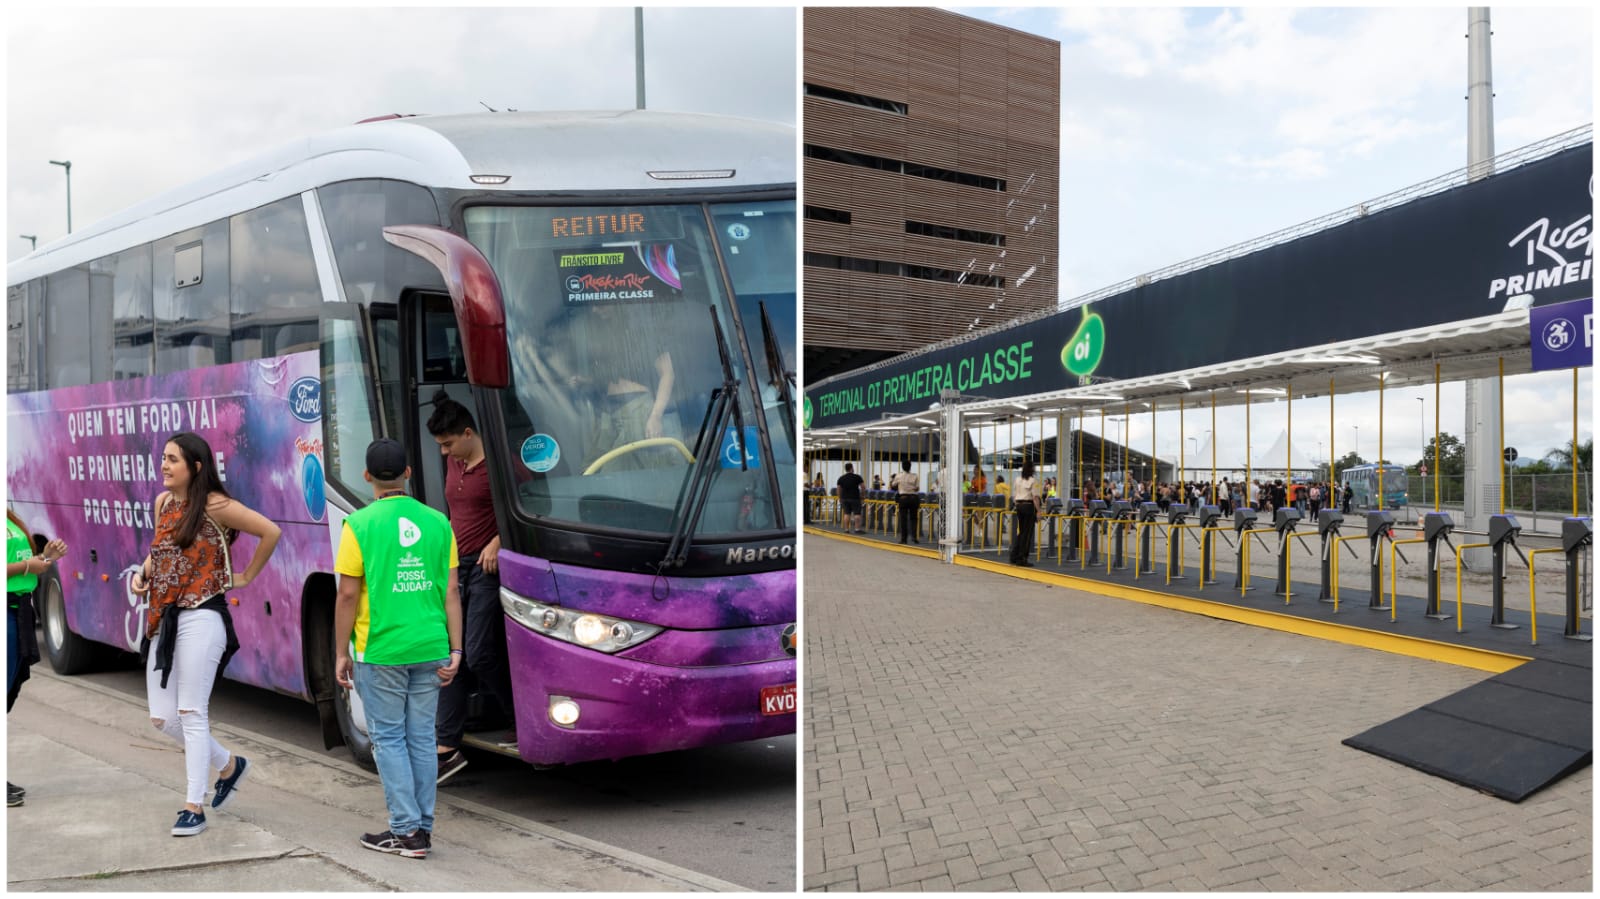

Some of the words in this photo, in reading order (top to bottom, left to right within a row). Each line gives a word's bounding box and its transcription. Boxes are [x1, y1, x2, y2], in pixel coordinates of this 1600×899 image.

[552, 213, 645, 237] REITUR
[600, 254, 622, 264] LIVRE
[568, 291, 617, 302] PRIMEIRA
[618, 290, 653, 299] CLASSE
[1074, 333, 1090, 360] oi
[819, 386, 866, 417] TERMINAL
[867, 382, 880, 408] OI
[882, 362, 954, 407] PRIMEIRA
[957, 341, 1034, 392] CLASSE
[295, 384, 321, 414] Ford
[68, 410, 103, 444] QUEM
[107, 406, 136, 436] TEM
[140, 402, 182, 433] FORD
[187, 398, 218, 431] VAI
[68, 455, 85, 481] DE
[88, 453, 157, 482] PRIMEIRA
[83, 498, 110, 525] PRO
[114, 499, 154, 529] ROCK
[404, 526, 415, 539] oi
[726, 544, 796, 564] Marco
[392, 580, 433, 593] AJUDAR?
